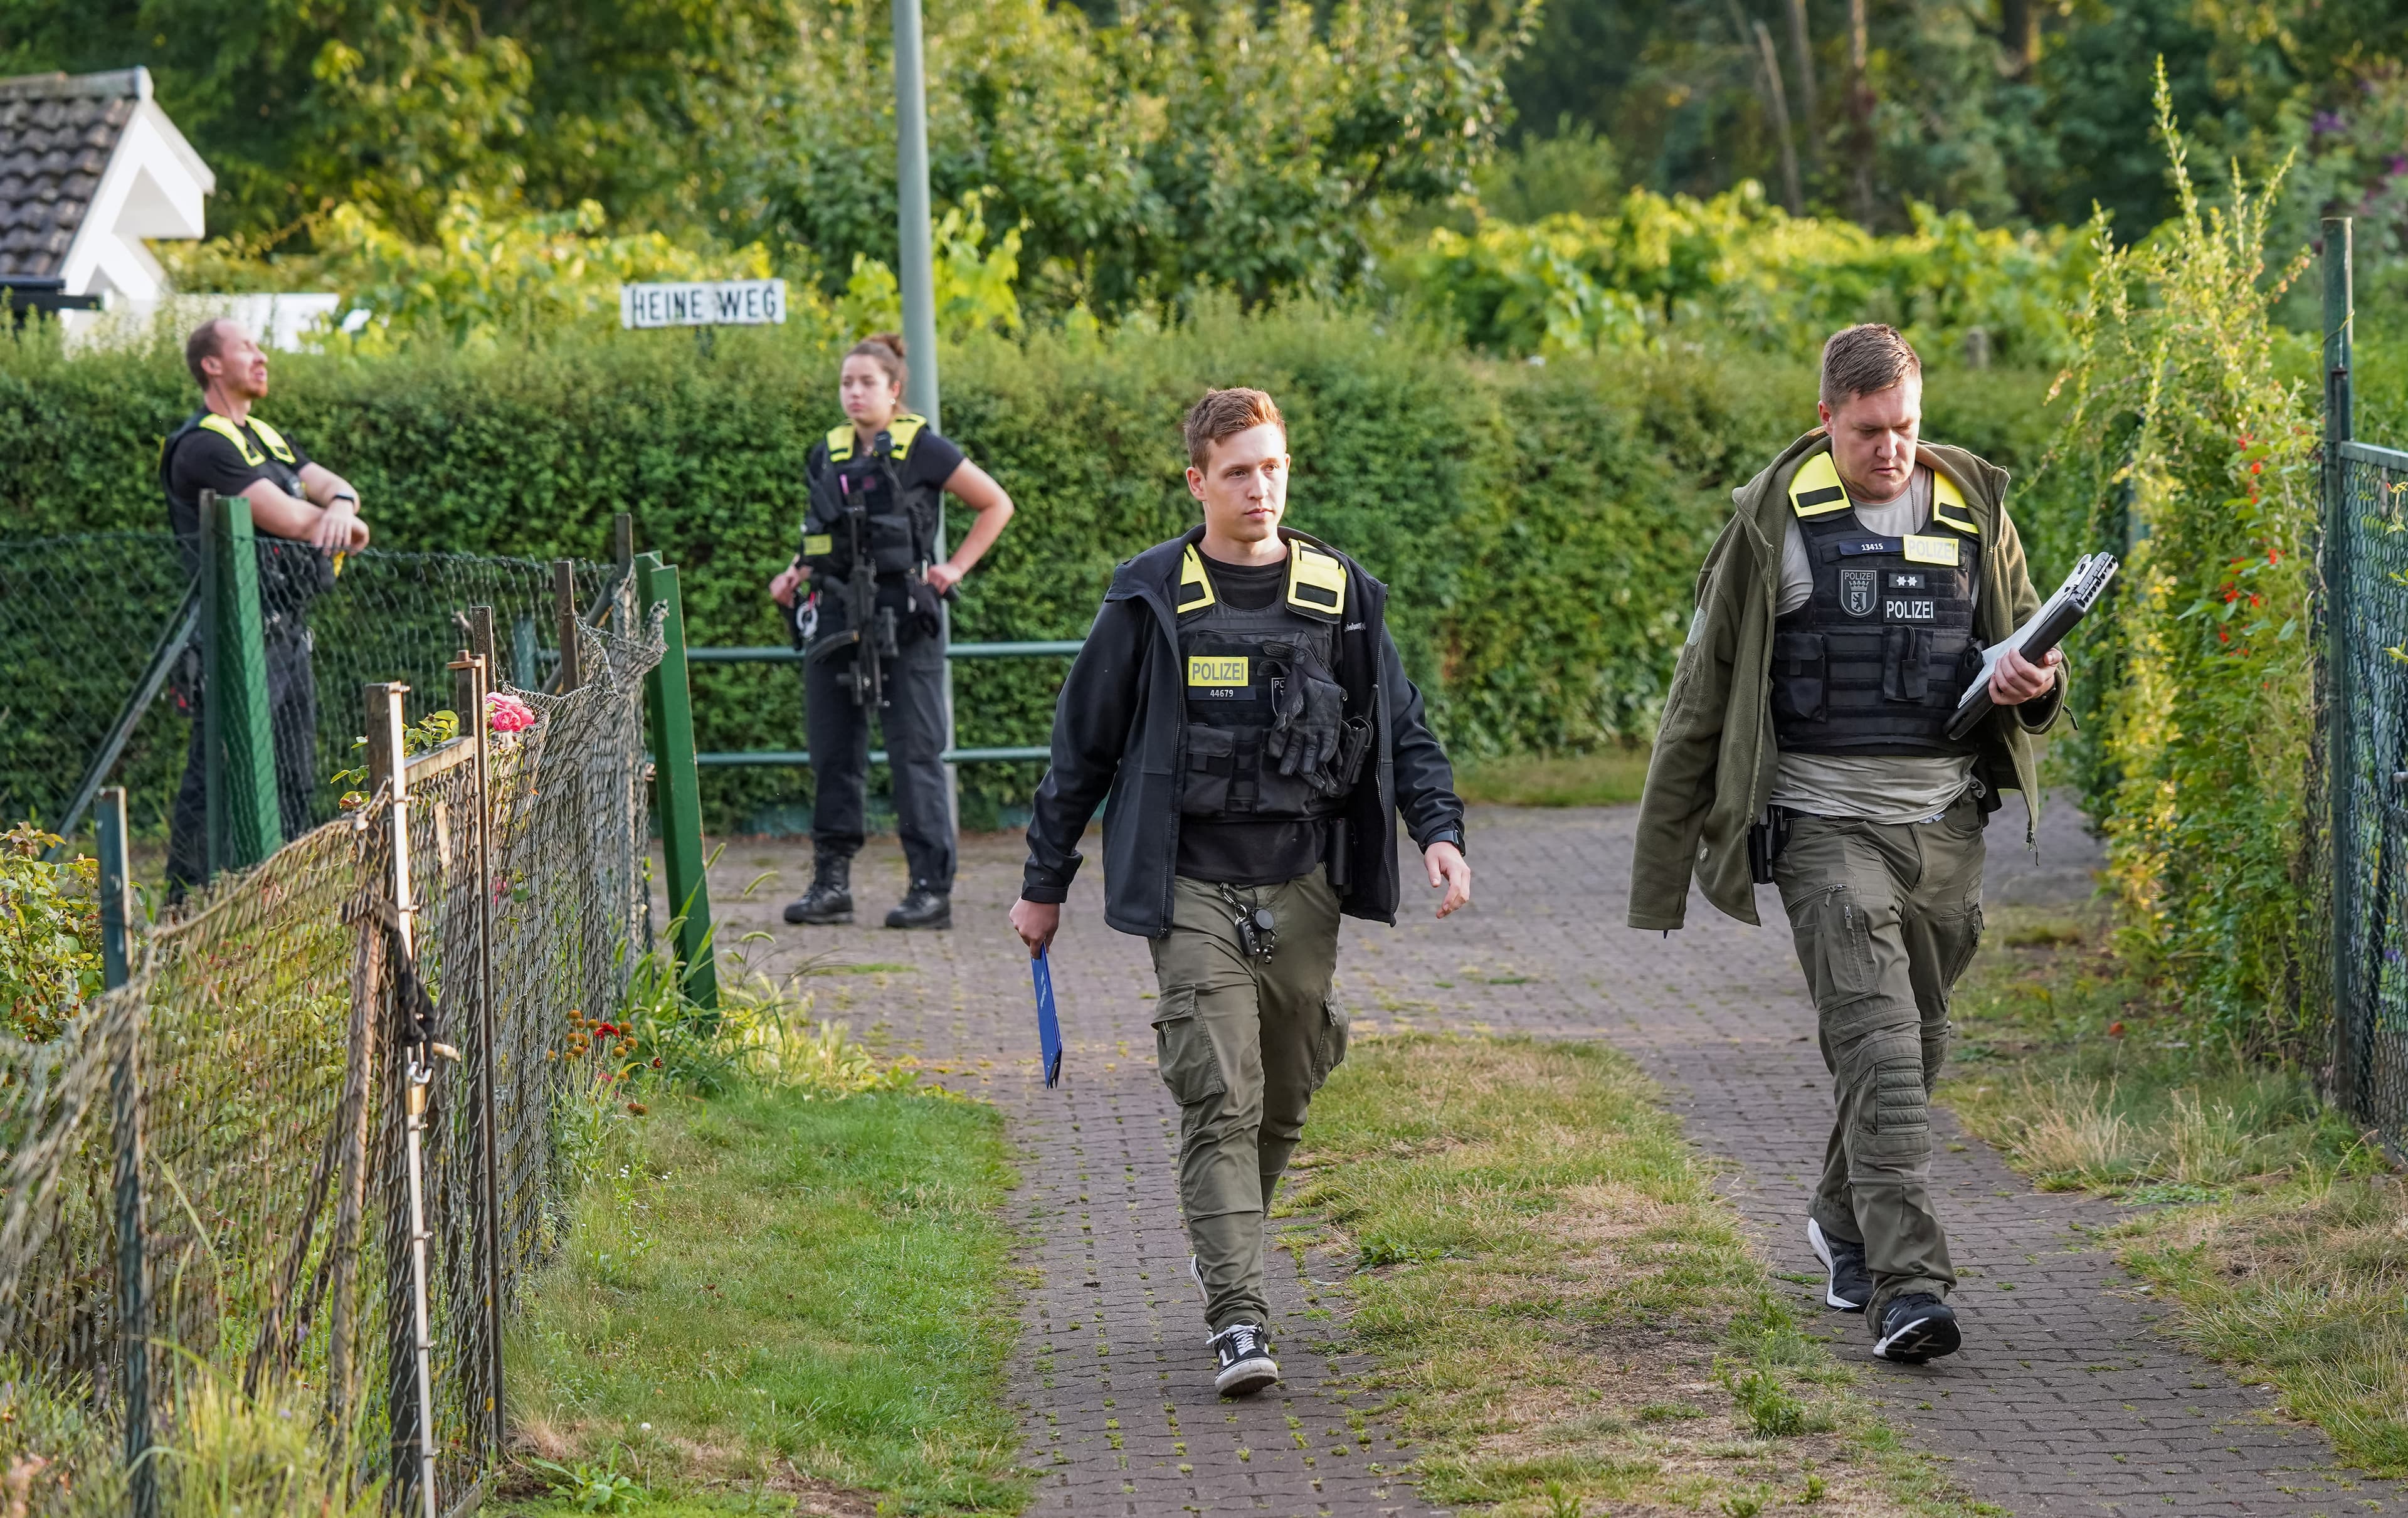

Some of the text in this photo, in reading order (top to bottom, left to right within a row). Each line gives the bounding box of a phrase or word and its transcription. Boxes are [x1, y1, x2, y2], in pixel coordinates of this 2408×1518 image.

[632, 287, 776, 320] HEINE WEG
[1908, 539, 1955, 561] POLIZEI
[1844, 572, 1873, 581] POLIZEI
[1886, 601, 1933, 619] POLIZEI
[1192, 663, 1244, 680] POLIZEI
[1210, 689, 1233, 697] 44679
